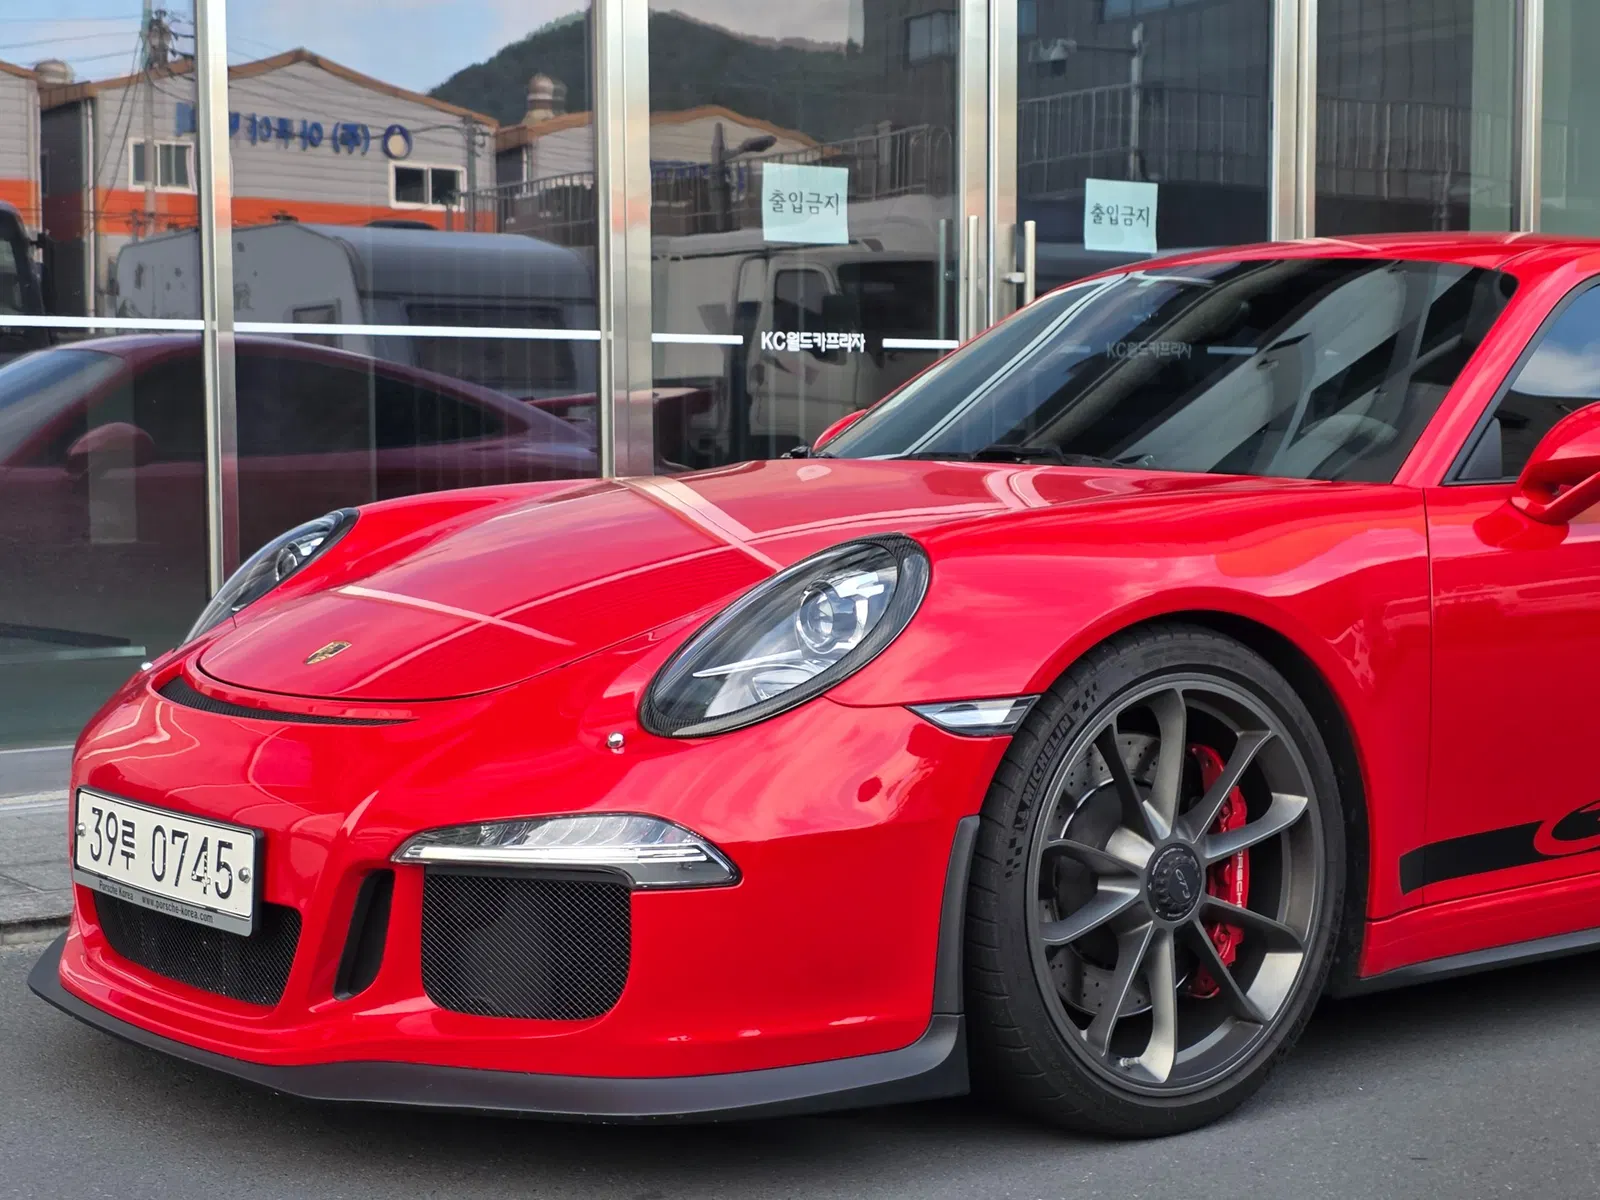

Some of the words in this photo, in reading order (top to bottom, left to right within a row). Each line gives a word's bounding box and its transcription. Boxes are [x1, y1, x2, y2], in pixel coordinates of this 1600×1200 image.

[768, 189, 840, 216] 출입금지
[1090, 202, 1150, 228] 출입금지
[760, 331, 866, 353] KC월드카프라자
[1021, 714, 1073, 806] MICHELIN
[151, 824, 234, 900] 0745
[119, 885, 134, 901] Korea
